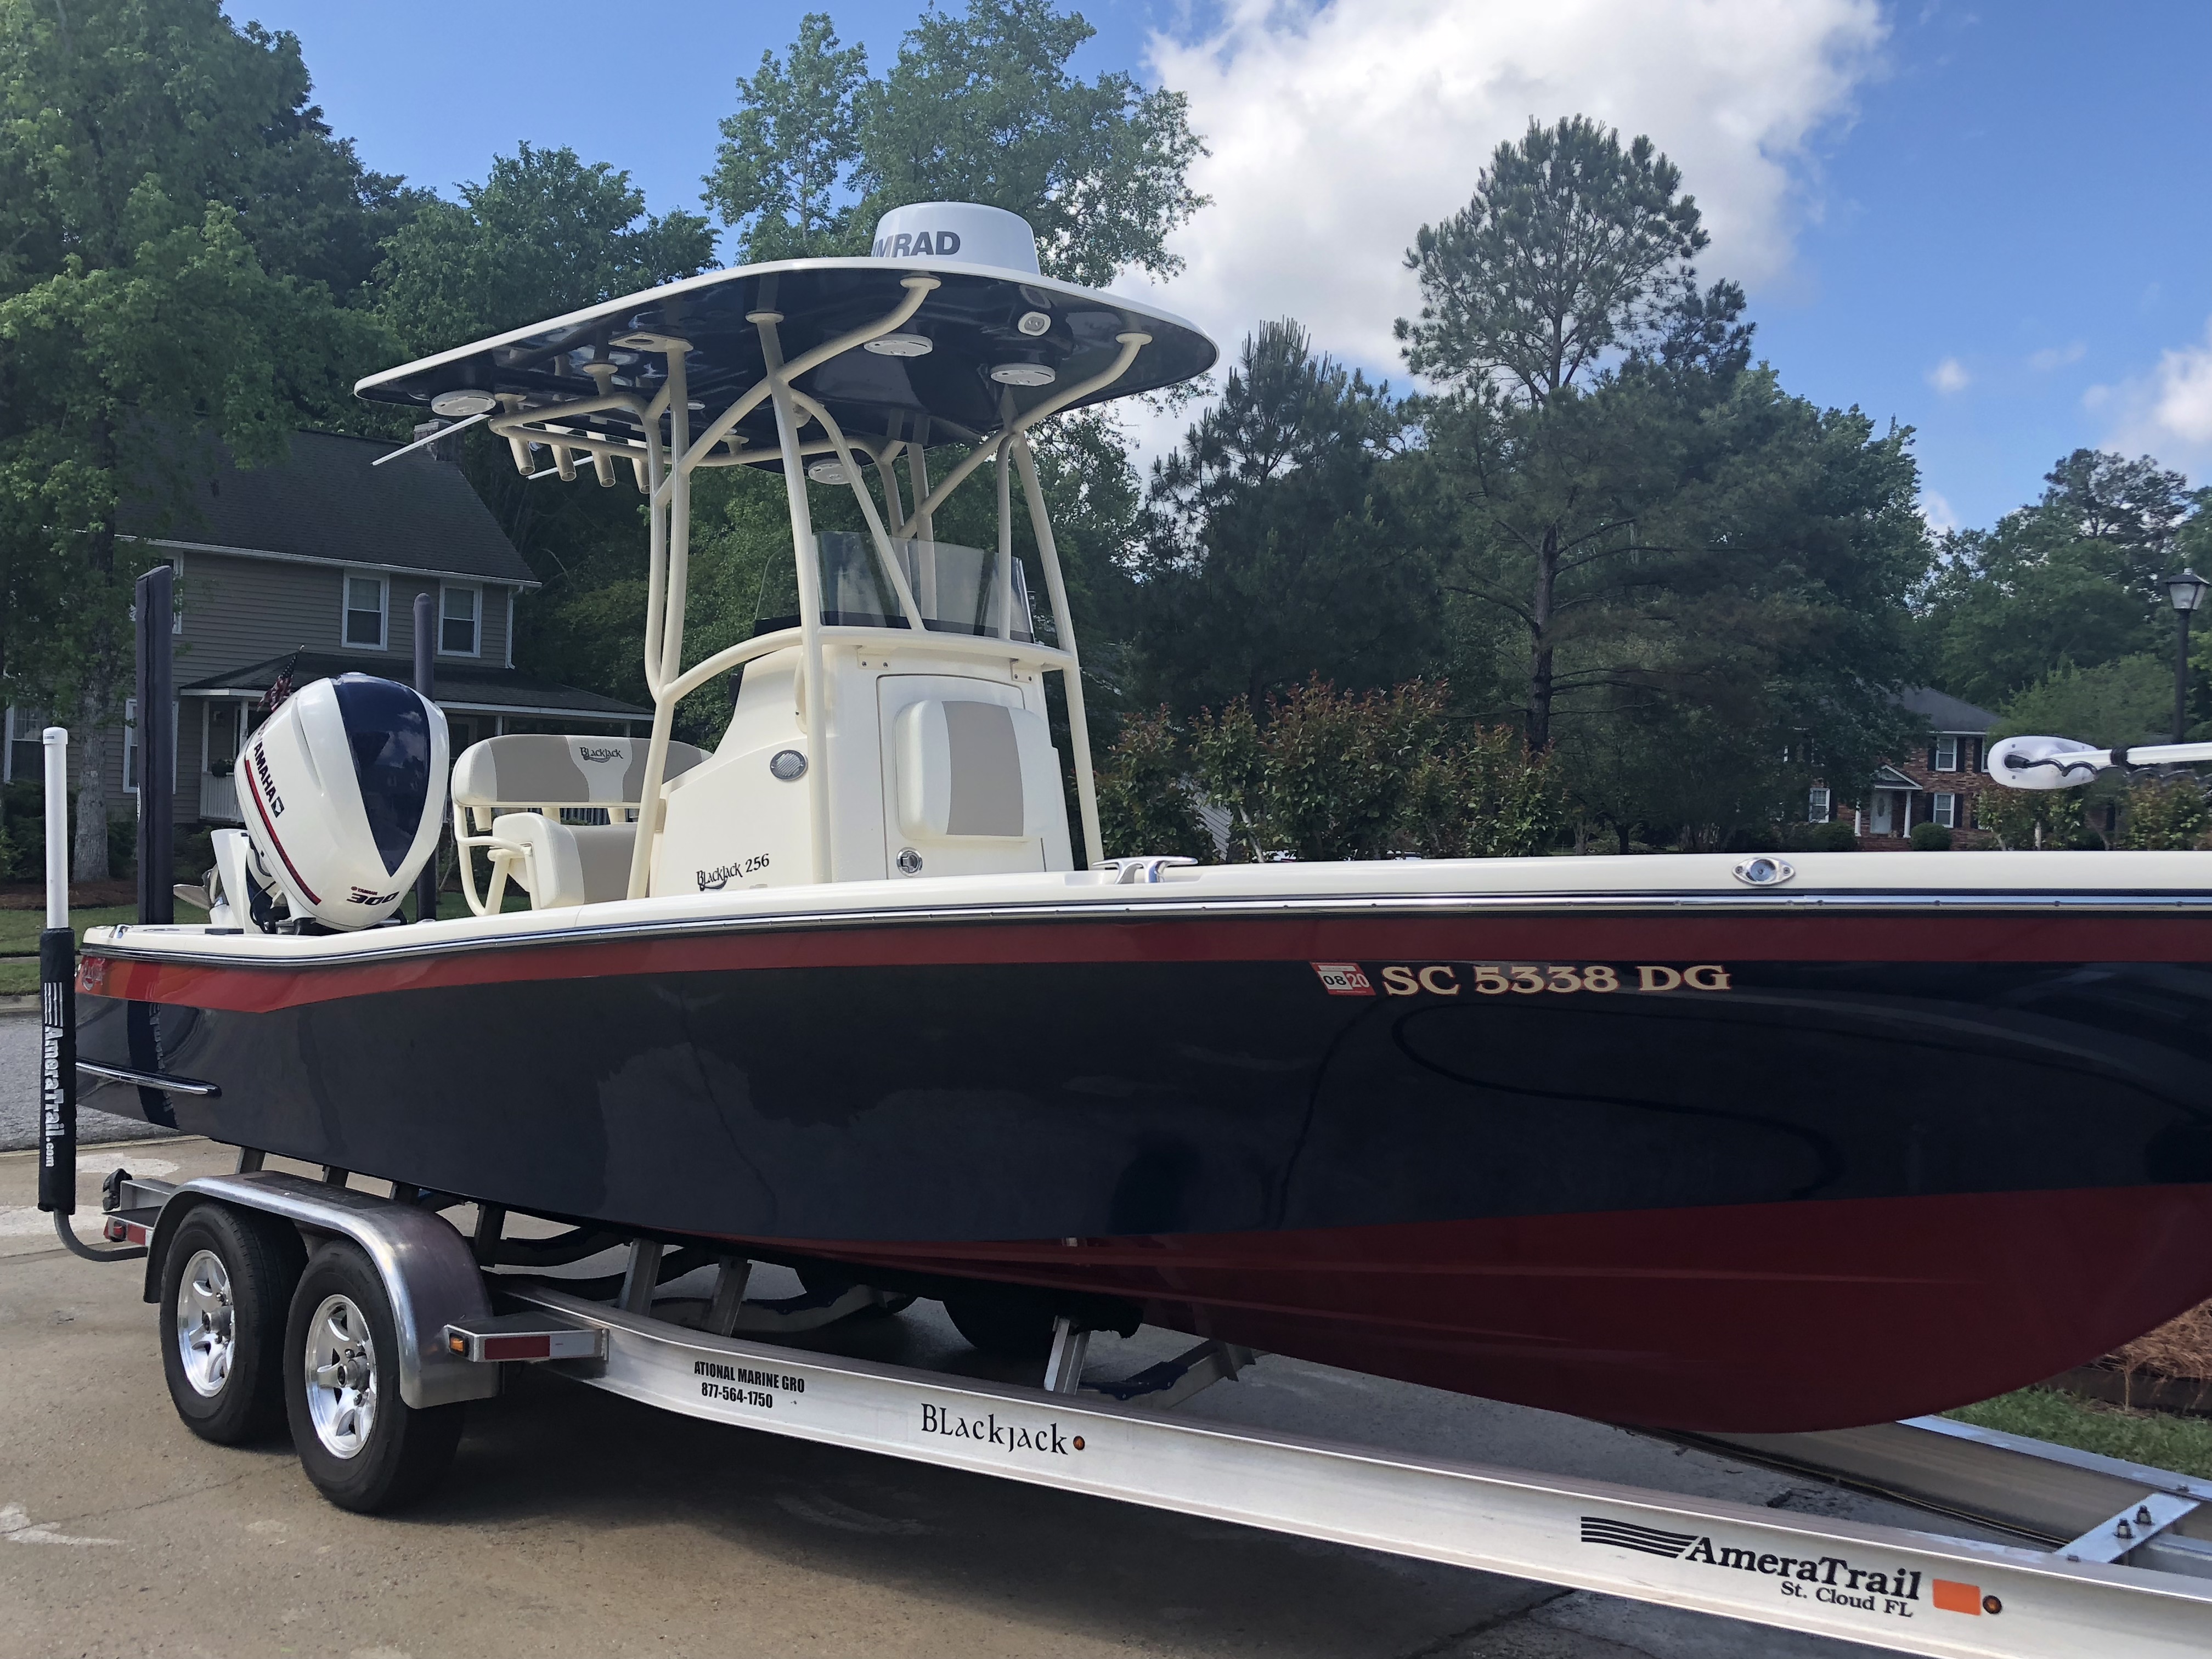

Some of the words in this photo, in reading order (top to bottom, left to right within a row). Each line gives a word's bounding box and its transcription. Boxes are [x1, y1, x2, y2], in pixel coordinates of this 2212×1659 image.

[745, 853, 770, 873] 256
[346, 891, 399, 905] 300
[1323, 975, 1346, 985] 08
[1346, 973, 1370, 988] 20
[1381, 966, 1461, 996] SC
[1475, 966, 1619, 995] 5338
[1637, 964, 1731, 991] DG
[737, 1368, 779, 1389] MARINE
[781, 1375, 805, 1393] GRO
[701, 1382, 773, 1408] 877-564-1750
[1685, 1537, 1922, 1600] AmeraTrail
[1781, 1581, 1807, 1599] St.
[1815, 1587, 1875, 1611] Cloud
[1883, 1599, 1914, 1618] FL
